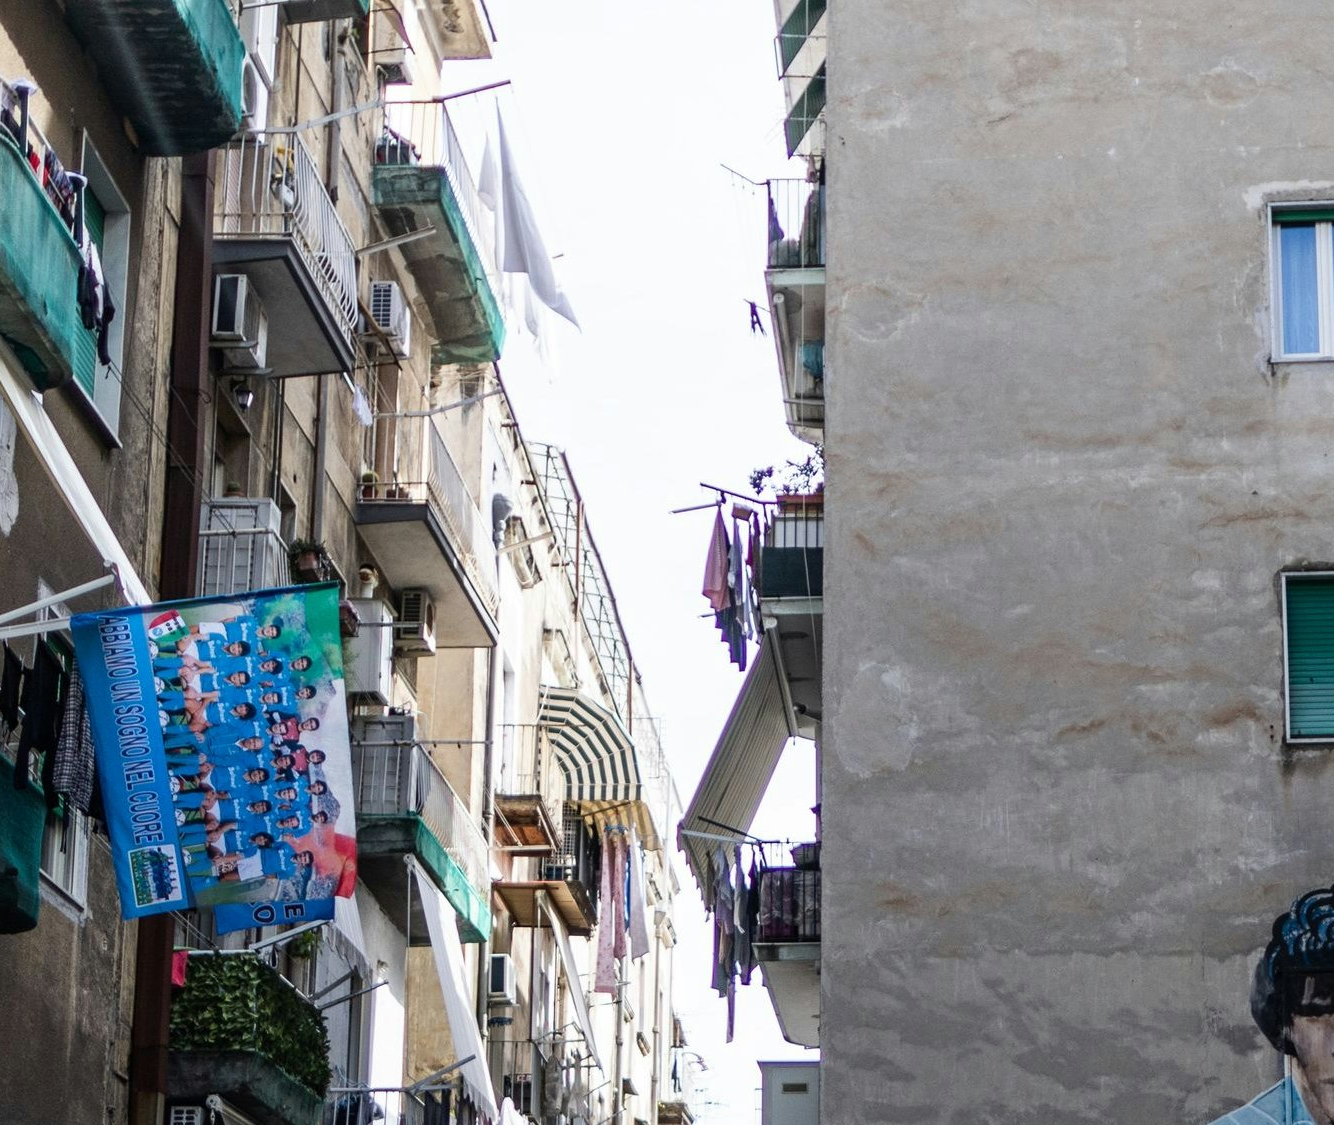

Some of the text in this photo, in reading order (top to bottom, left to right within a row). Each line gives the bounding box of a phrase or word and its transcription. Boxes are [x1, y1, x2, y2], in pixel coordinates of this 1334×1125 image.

[97, 615, 165, 846] ABBIAMO UN SOGNO NEL CUORE
